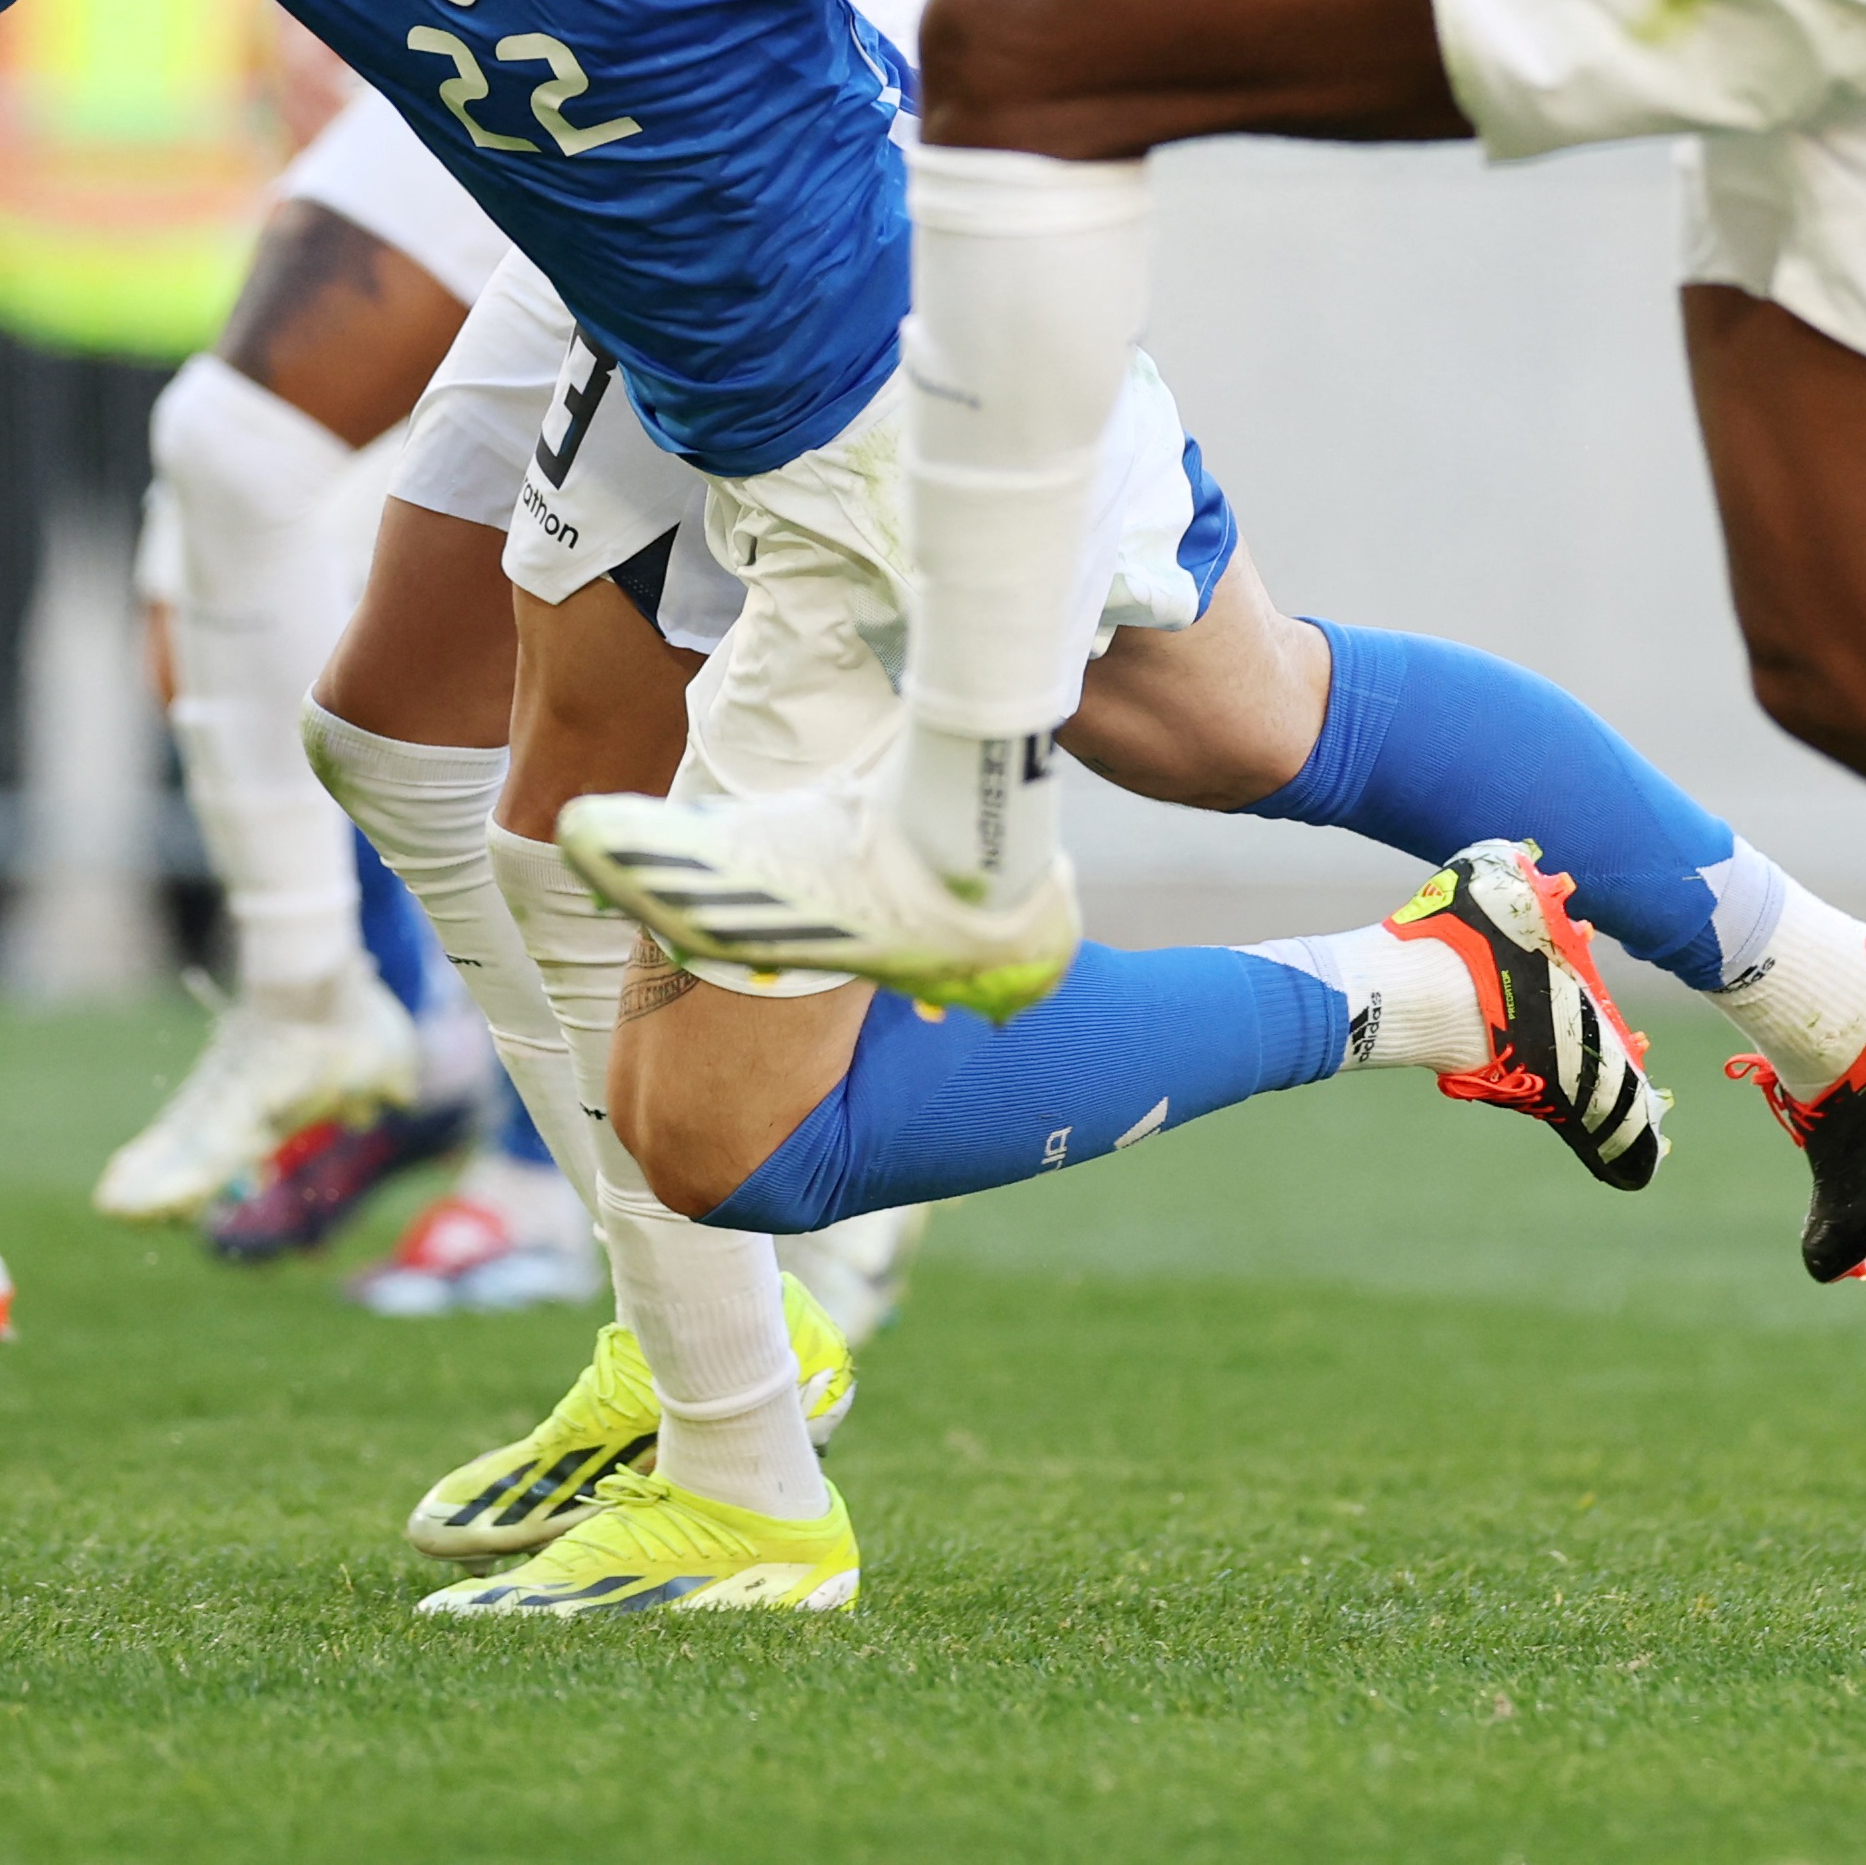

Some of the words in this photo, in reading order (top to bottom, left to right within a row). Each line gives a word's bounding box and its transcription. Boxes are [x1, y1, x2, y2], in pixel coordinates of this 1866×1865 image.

[406, 24, 643, 157] 22
[1359, 991, 1383, 1063] adidas
[1500, 969, 1517, 1021] PREDATOR
